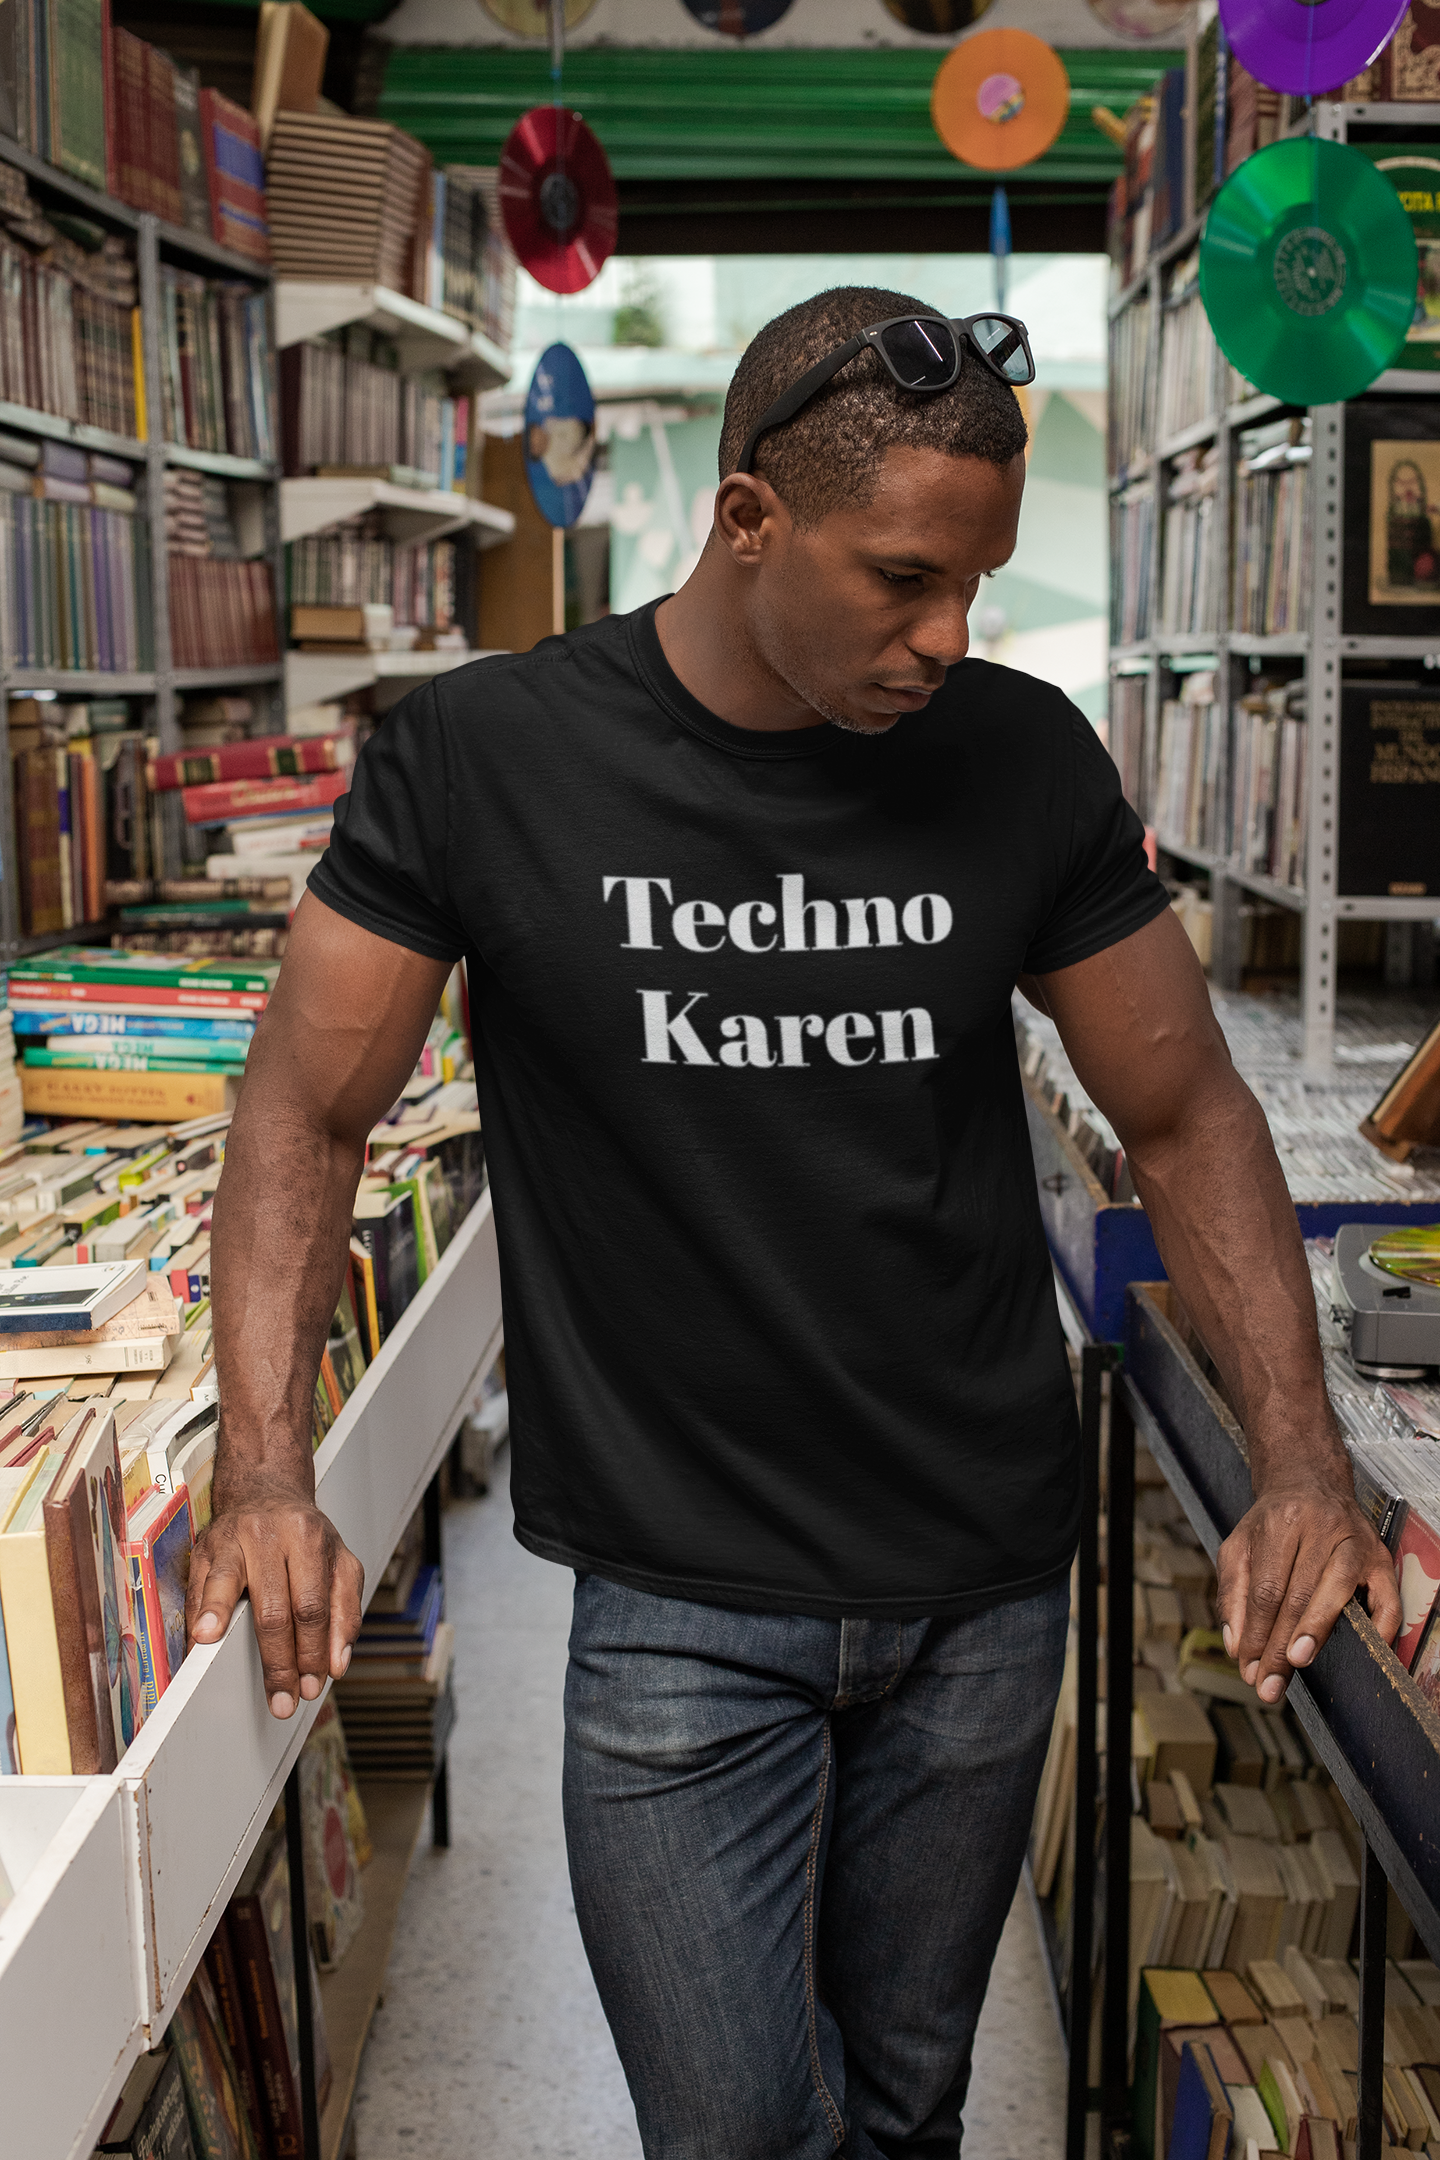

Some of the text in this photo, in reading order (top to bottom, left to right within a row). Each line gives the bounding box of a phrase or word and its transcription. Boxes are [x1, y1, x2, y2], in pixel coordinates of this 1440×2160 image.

[602, 873, 953, 952] Techno
[71, 1014, 126, 1034] MEGA
[636, 988, 940, 1068] Karen
[95, 1054, 149, 1072] MEGA
